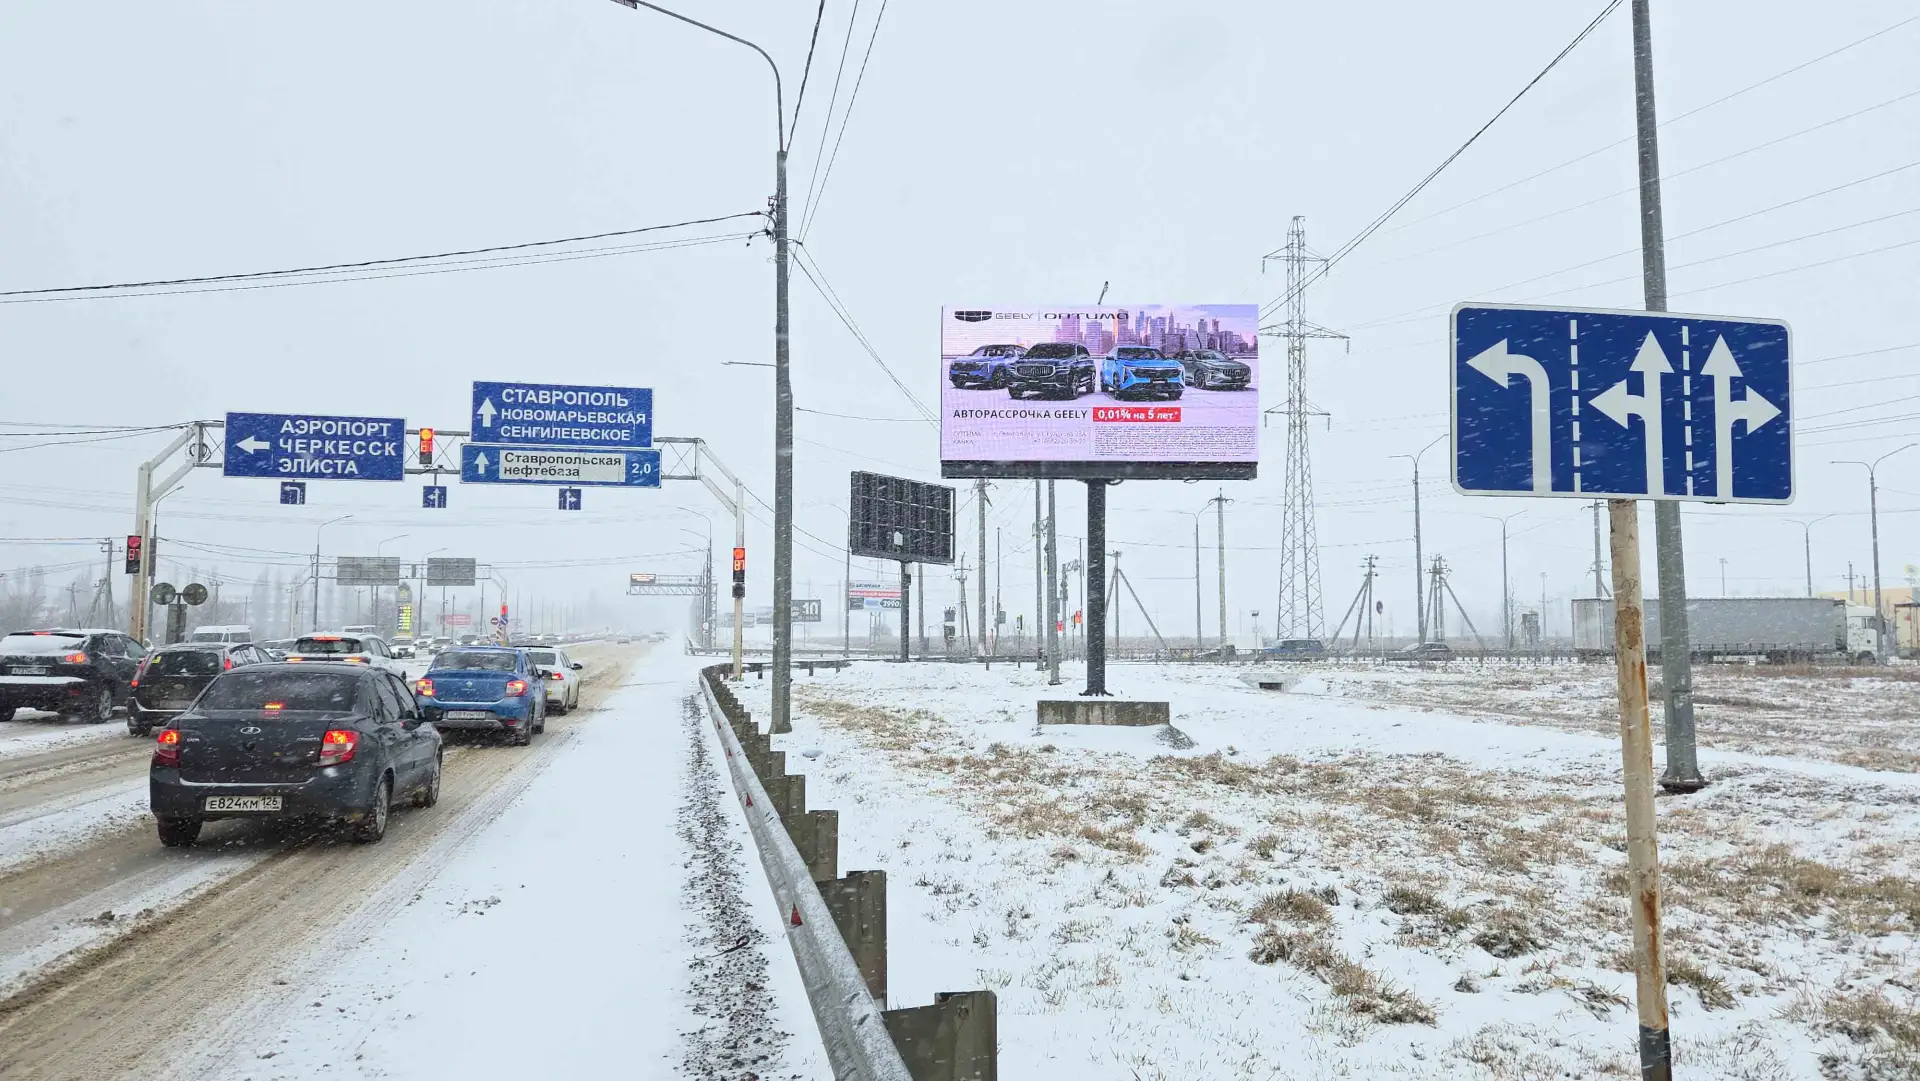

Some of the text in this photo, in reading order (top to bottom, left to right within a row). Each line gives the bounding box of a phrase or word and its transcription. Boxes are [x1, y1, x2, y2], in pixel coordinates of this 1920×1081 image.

[995, 312, 1034, 320] GEELY
[501, 388, 629, 407] СТАВРОПОЛЬ
[501, 408, 646, 425] НОВОМАРЬЕВСКАЯ
[953, 409, 1088, 419] АВТОРАССРОЧКА GEELY
[1097, 409, 1131, 420] 0,01%
[1133, 412, 1145, 420] на
[1147, 409, 1154, 420] 5
[280, 419, 392, 437] АЭРОПОРТ
[500, 425, 631, 441] СЕНГИЛЕЕВСКОЕ
[279, 438, 397, 456] ЧЕРКЕССК
[504, 452, 622, 466] Ставропольская
[278, 458, 359, 475] ЭЛИСТА
[504, 464, 580, 478] нефтебаза
[631, 462, 651, 475] 2,0
[209, 796, 278, 810] Е824КМ 126
